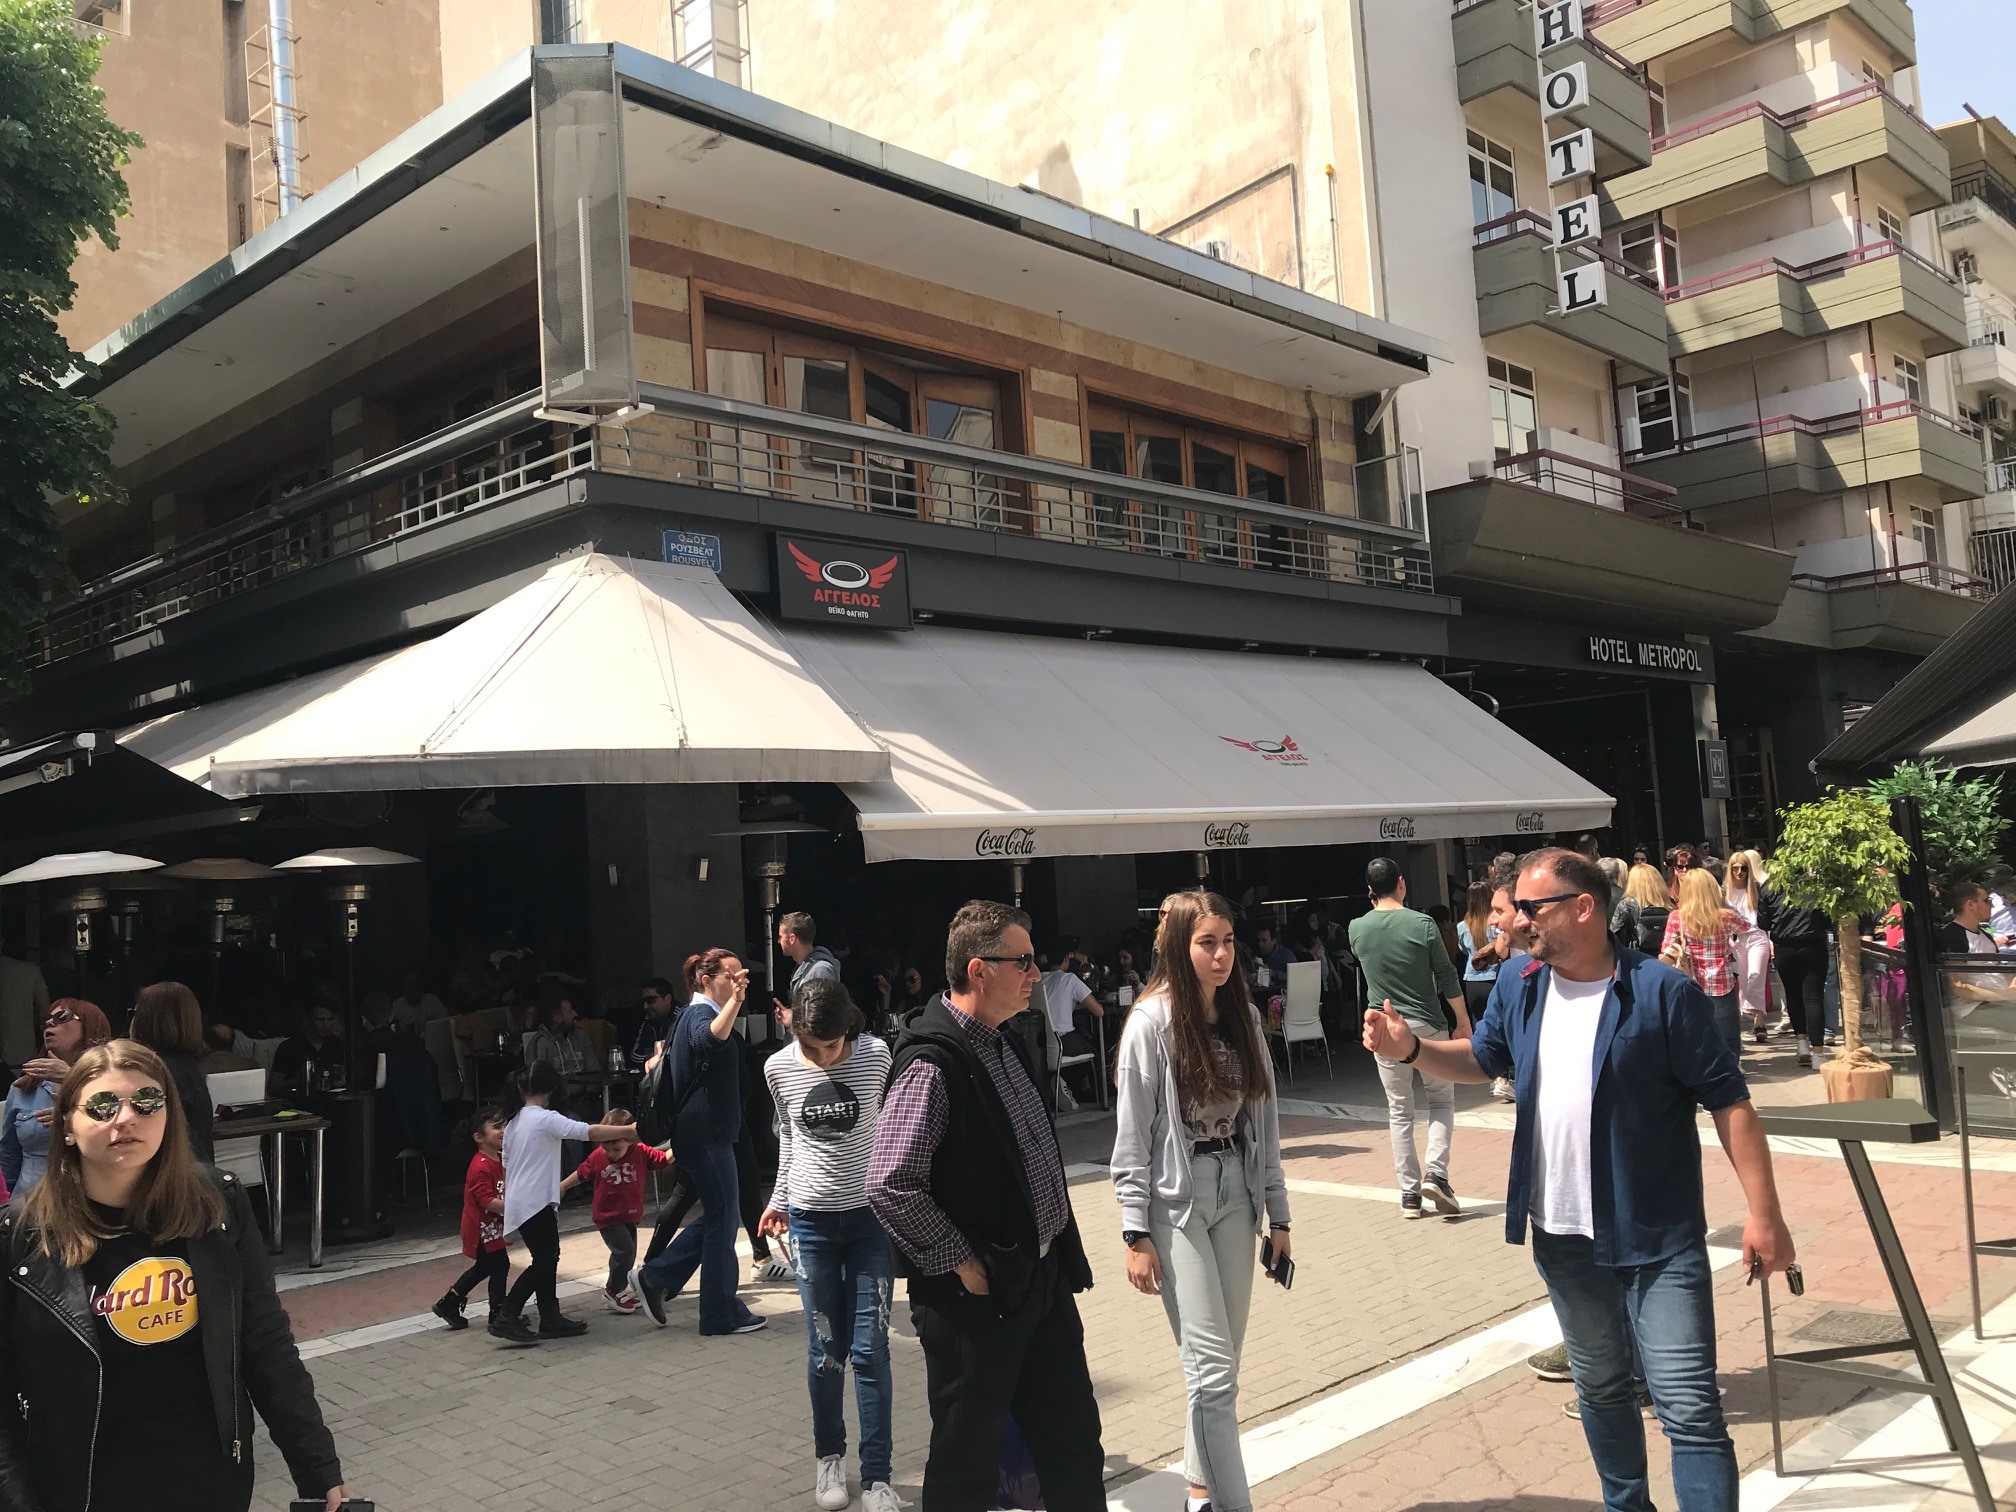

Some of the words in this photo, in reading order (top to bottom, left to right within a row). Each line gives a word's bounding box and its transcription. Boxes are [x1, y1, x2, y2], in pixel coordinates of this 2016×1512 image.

[1538, 1, 1597, 311] HOTEL
[678, 533, 707, 545] ΟΔΟΣ
[670, 542, 714, 557] ΡΟΥΣΒΕΛΤ
[671, 554, 716, 568] ROUSVELT
[813, 588, 881, 608] ΑΓΓΕΛΟΣ
[846, 609, 869, 619] ΦΑΓΗΤΟ
[1589, 636, 1633, 664] HOTEL
[1638, 642, 1702, 671] METROPOL
[804, 1101, 857, 1121] START
[137, 1309, 184, 1330] CAFE
